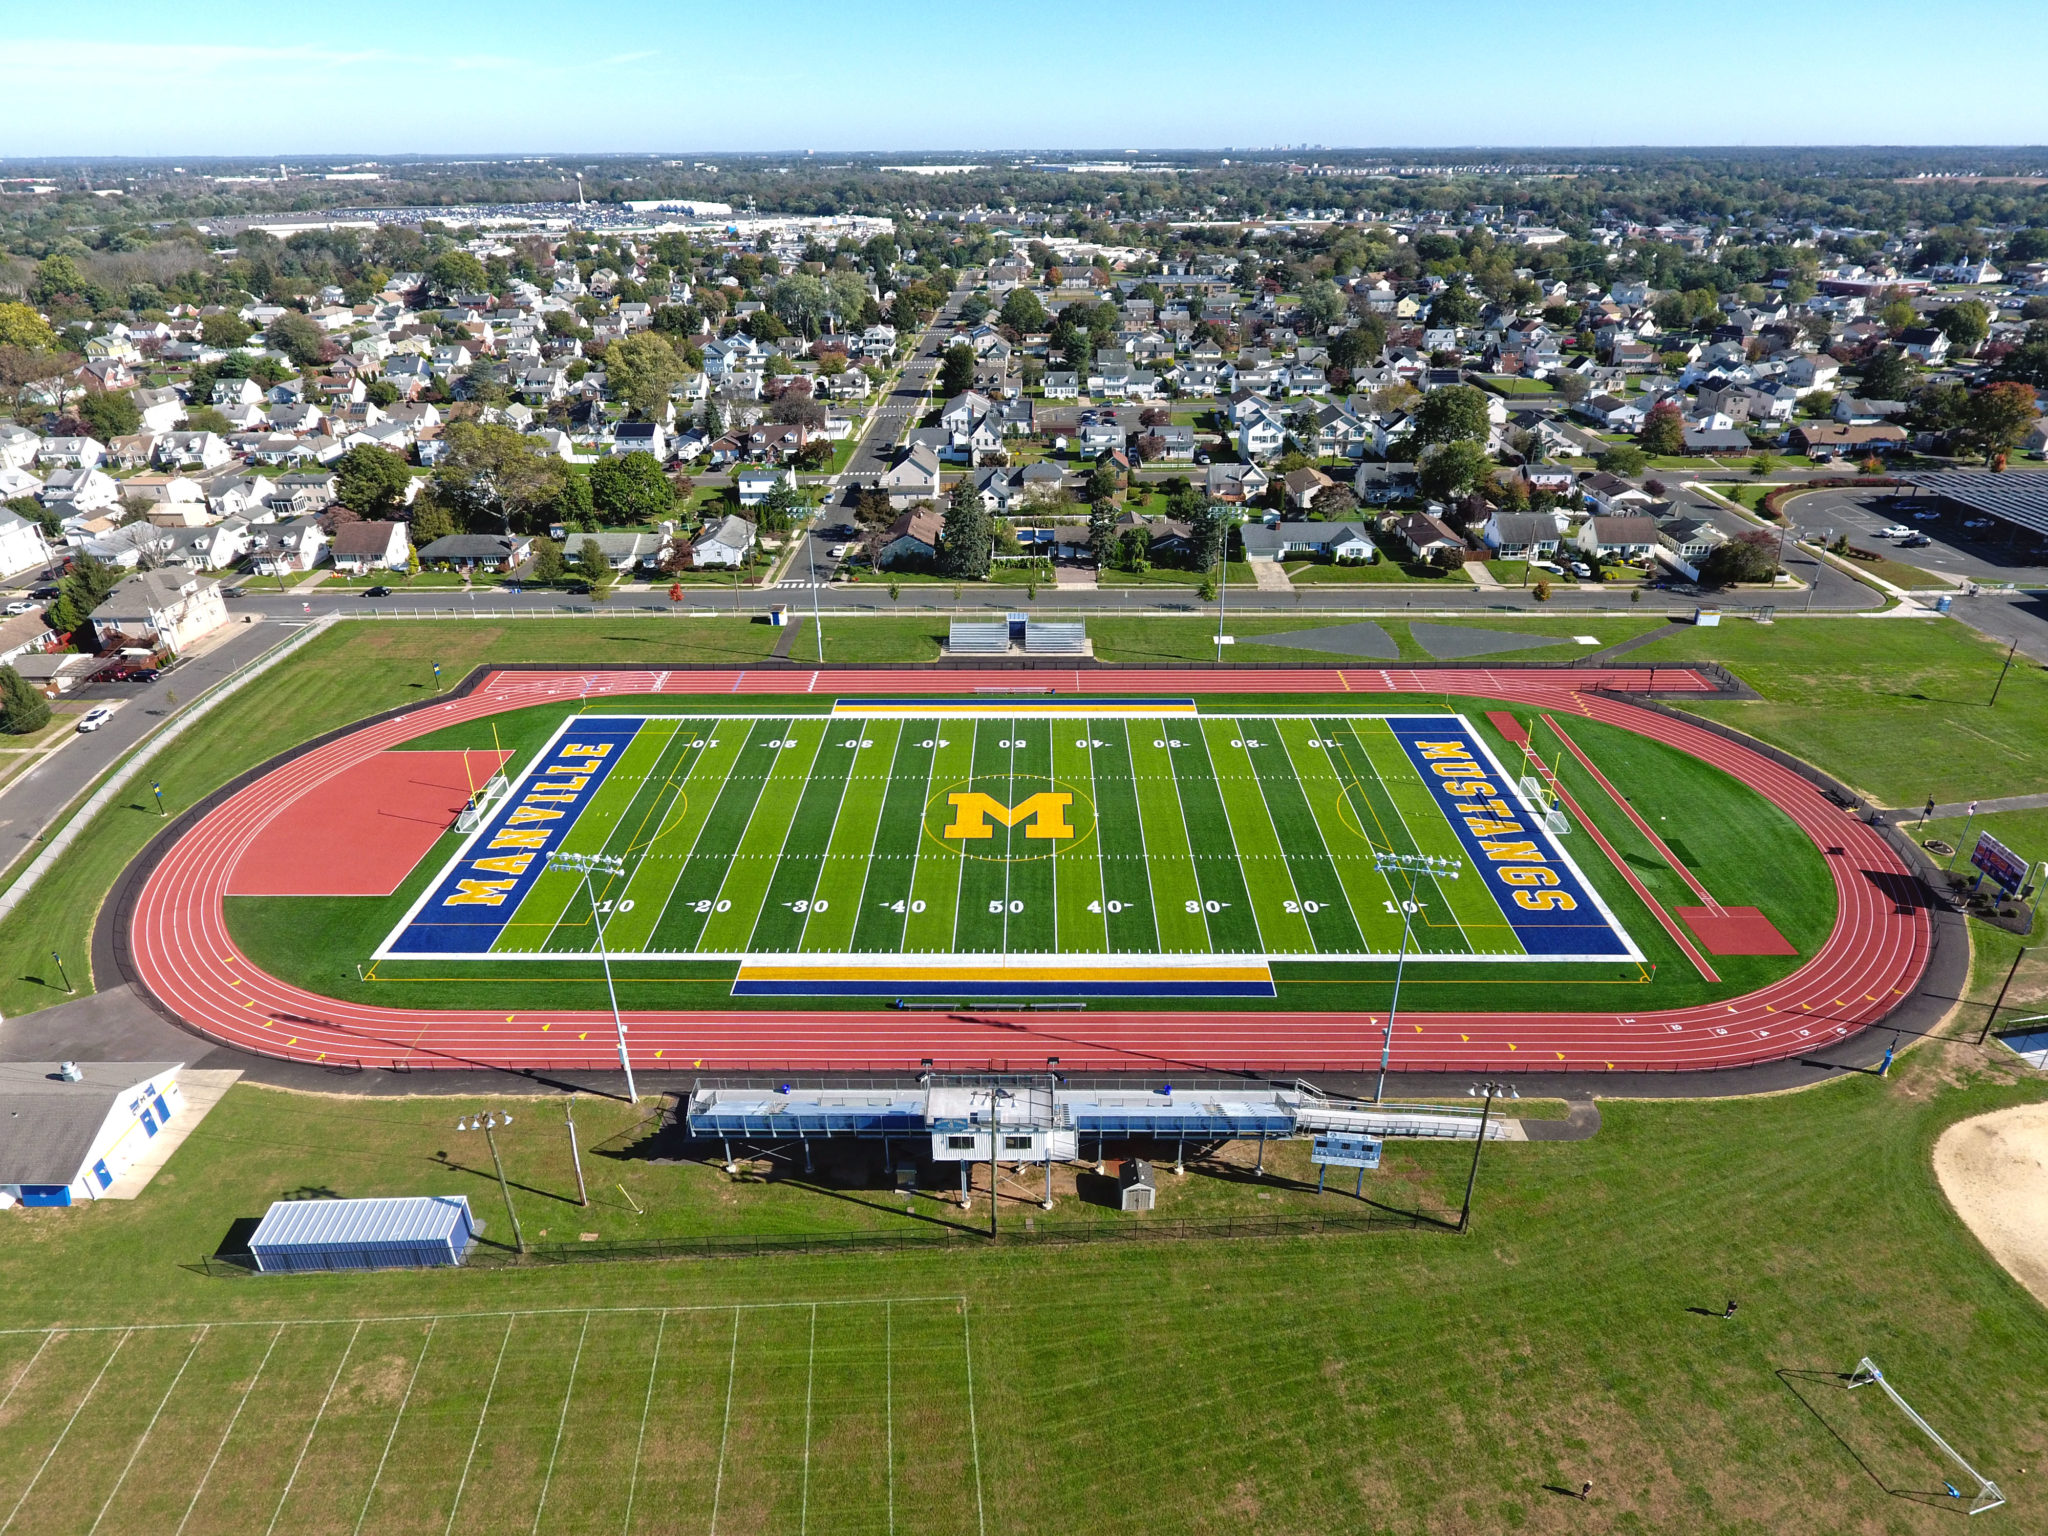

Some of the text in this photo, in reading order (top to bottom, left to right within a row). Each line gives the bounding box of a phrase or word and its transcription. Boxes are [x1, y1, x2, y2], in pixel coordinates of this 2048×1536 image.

[768, 739, 799, 749] 20
[922, 739, 951, 749] 40
[998, 739, 1027, 749] 50
[1075, 739, 1105, 749] 40
[943, 792, 1075, 839] M
[442, 743, 614, 906] MANVILLE
[1414, 741, 1578, 911] MUSTANGS
[598, 899, 635, 913] 10
[694, 899, 732, 913] 20
[792, 900, 829, 913] 30
[890, 900, 926, 913] 40
[988, 900, 1024, 913] 50
[1086, 900, 1122, 913] 40
[1185, 900, 1221, 914] 30
[1282, 900, 1319, 914] 20
[1382, 900, 1419, 914] 10
